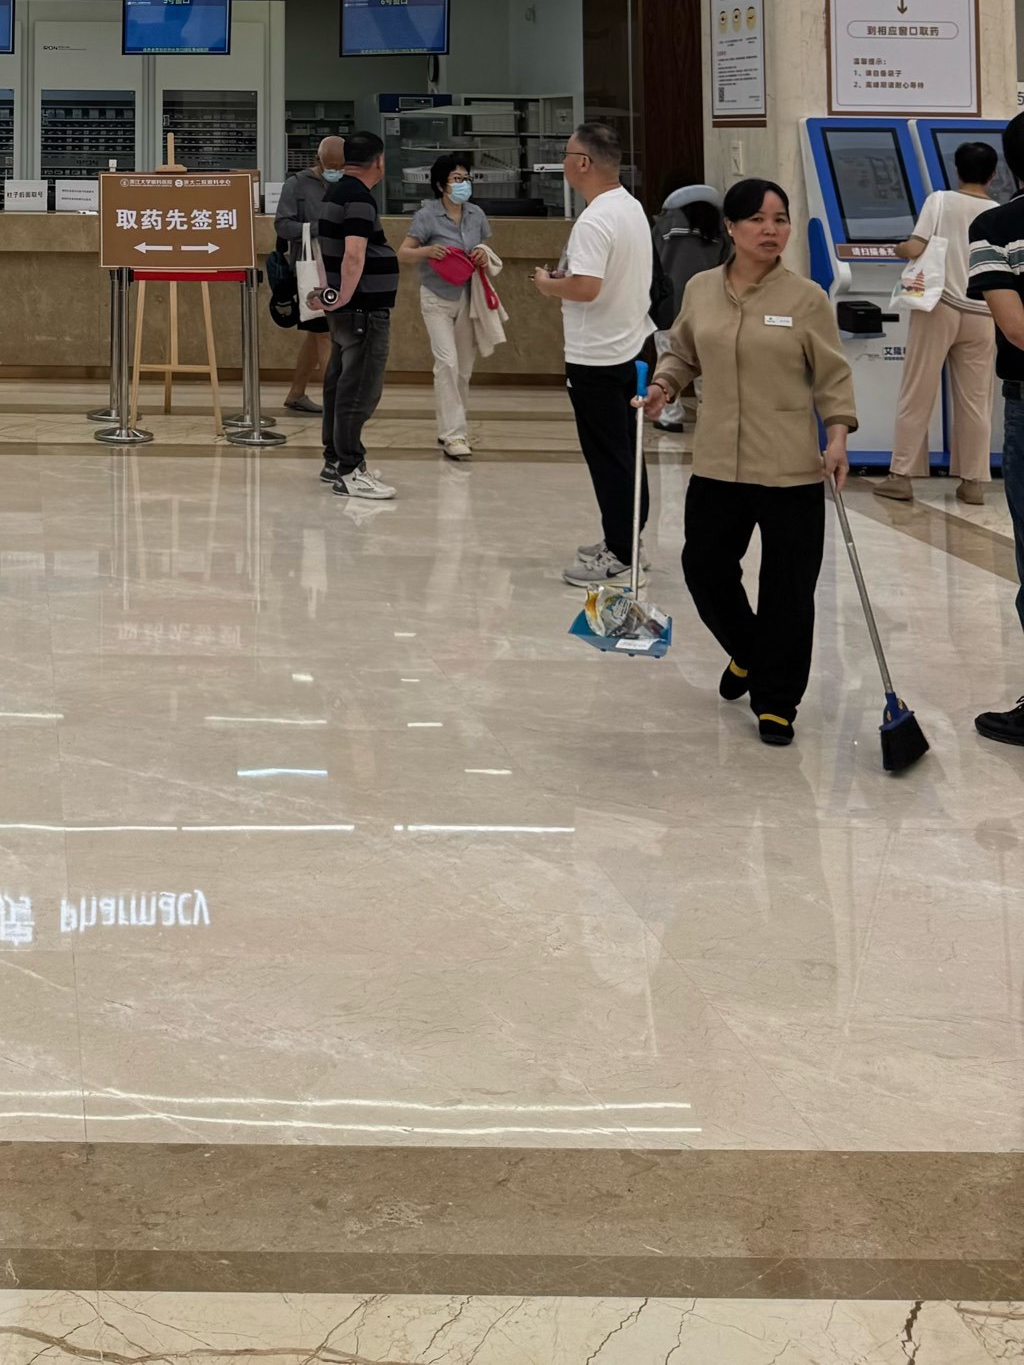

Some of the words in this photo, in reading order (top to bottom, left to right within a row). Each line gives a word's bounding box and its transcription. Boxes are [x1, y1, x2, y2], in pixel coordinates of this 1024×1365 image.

[866, 25, 940, 37] 到相应窗口取药
[116, 208, 238, 231] 取药先签到
[884, 346, 906, 356] 艾隆
